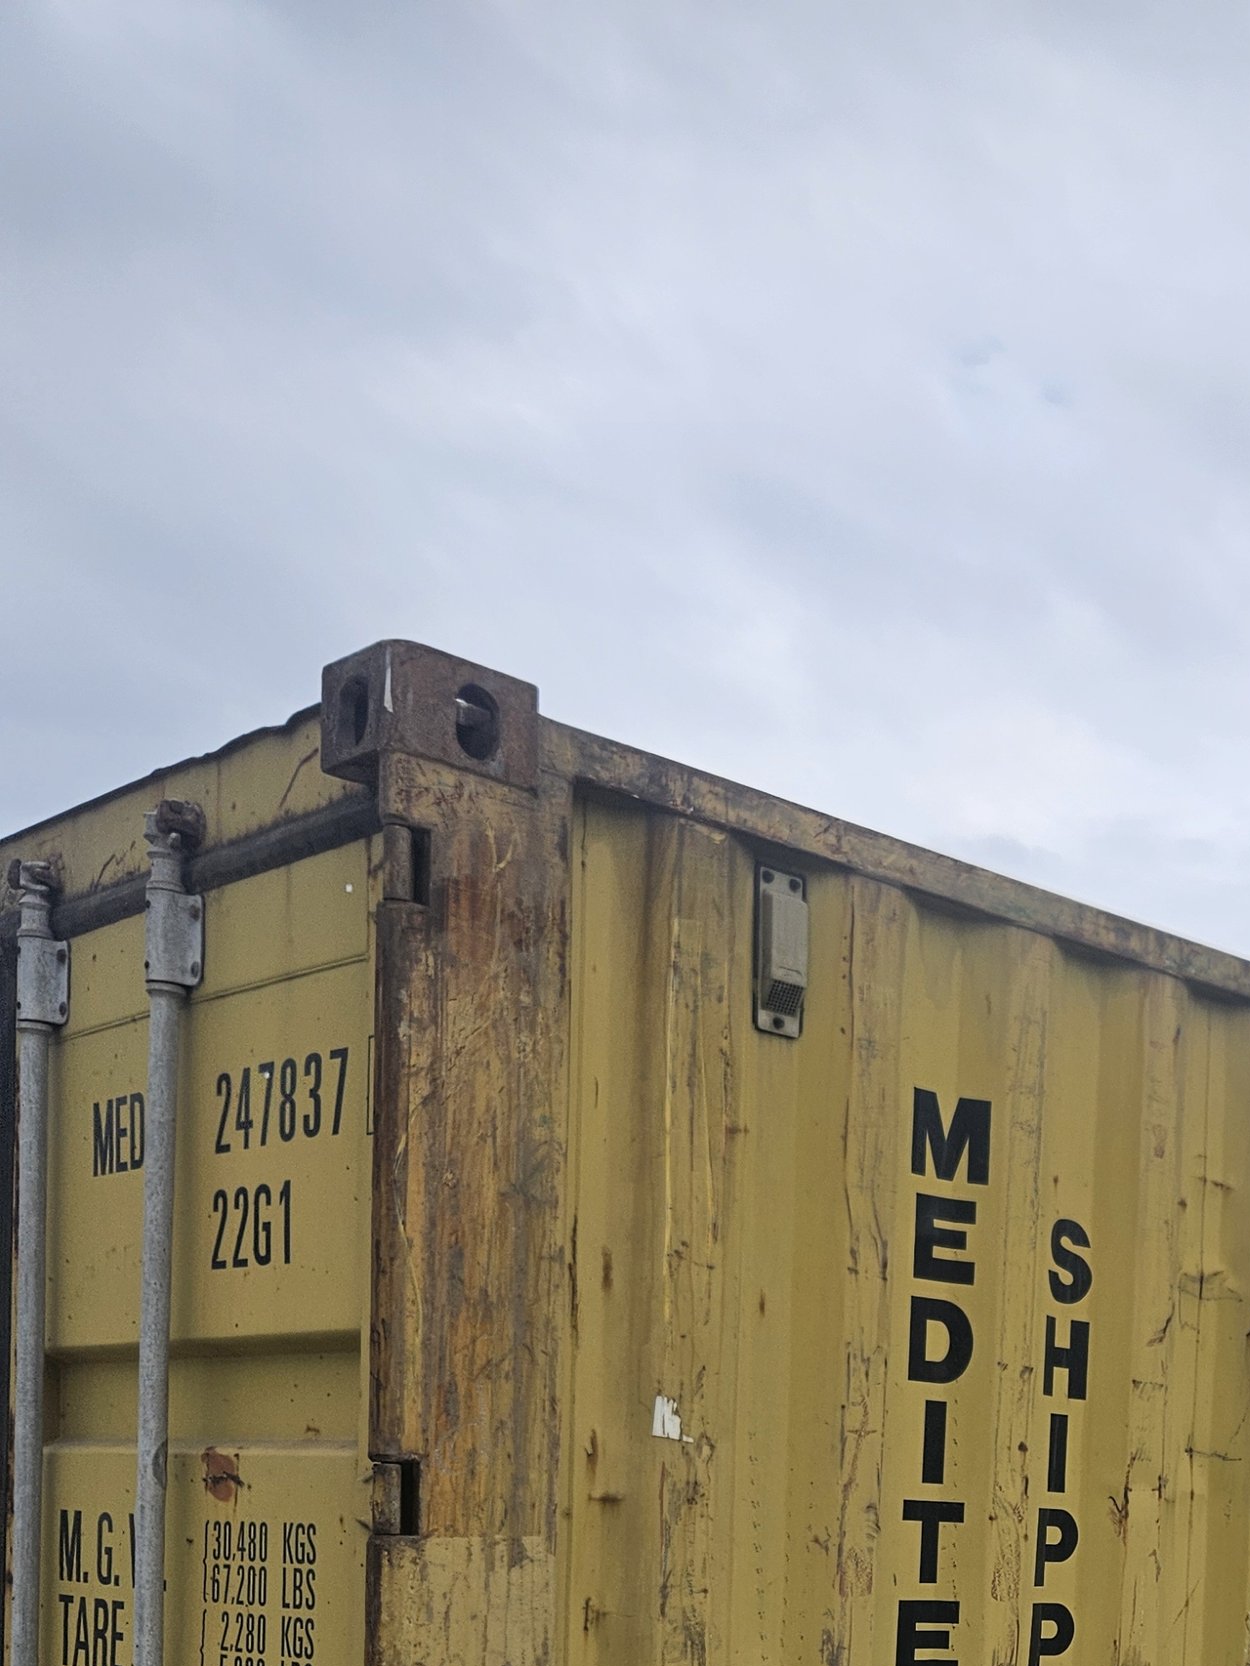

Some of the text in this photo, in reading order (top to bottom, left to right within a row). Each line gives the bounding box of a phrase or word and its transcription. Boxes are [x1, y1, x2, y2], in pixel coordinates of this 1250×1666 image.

[215, 1047, 349, 1154] 247837
[211, 1179, 292, 1271] 22G1
[59, 1509, 316, 1592] M.G.. 30,480 KGS
[211, 1563, 316, 1610] 67,200 LBS
[220, 1611, 266, 1655] 2,280
[281, 1616, 315, 1660] KGS
